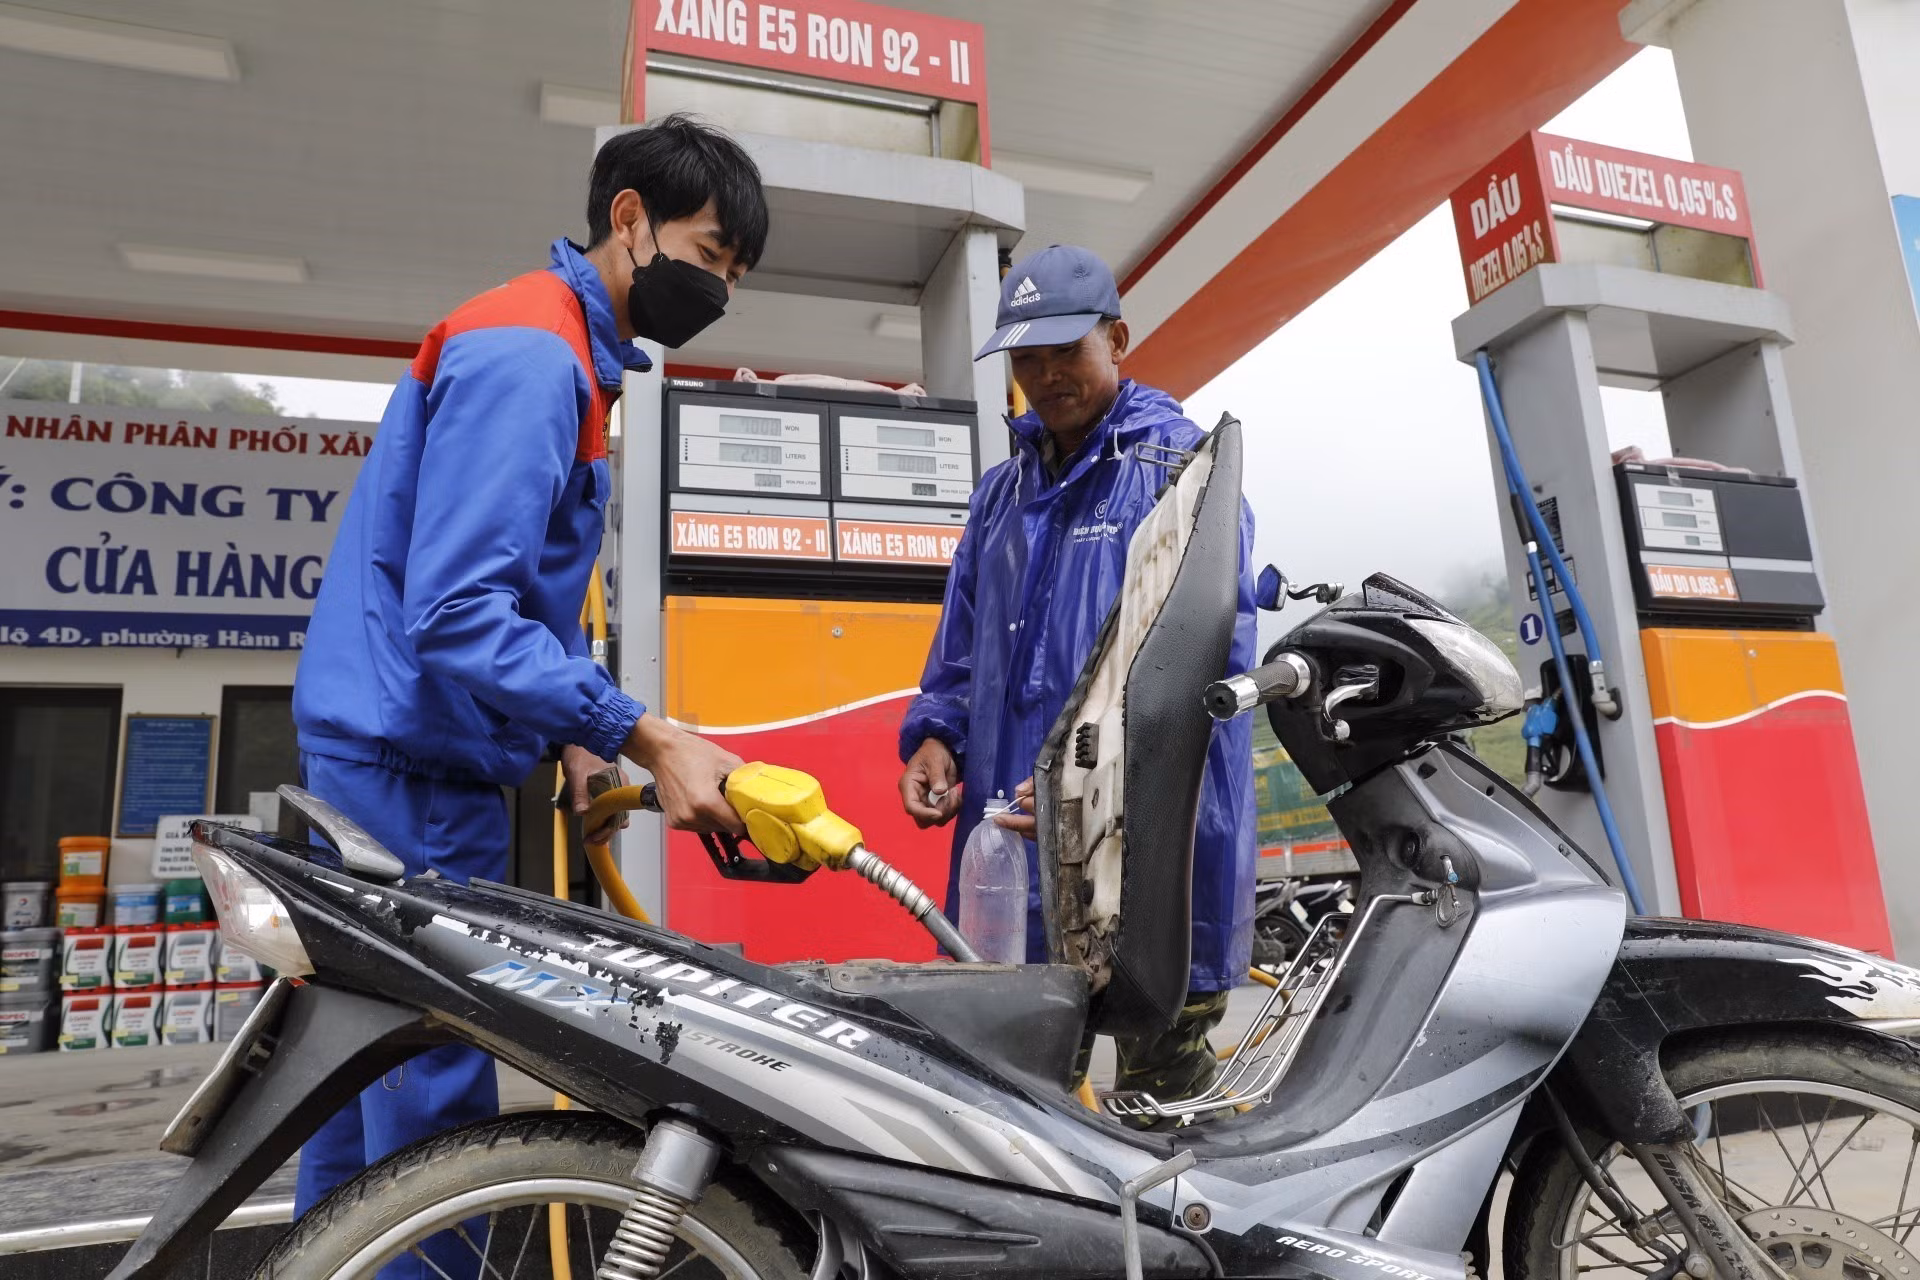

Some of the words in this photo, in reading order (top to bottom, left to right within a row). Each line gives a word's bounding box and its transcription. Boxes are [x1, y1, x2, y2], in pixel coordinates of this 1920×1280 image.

[759, 4, 797, 54] E5
[808, 12, 873, 68] RON
[883, 28, 920, 76] 92
[929, 56, 941, 66] -
[950, 39, 970, 86] II
[1550, 143, 1593, 194] DẦU
[1595, 159, 1664, 208] DIEZEL
[1663, 173, 1737, 221] 0,05%S
[1470, 172, 1521, 240] DẦU
[1469, 247, 1506, 301] DIEZEL
[1011, 292, 1041, 307] adidas
[673, 379, 704, 388] TATSUNO
[5, 414, 112, 443] NHÂN
[123, 421, 217, 449] PHÂN
[229, 425, 308, 454] PHỐI
[50, 472, 245, 518] CÔNG
[266, 487, 340, 523] TY
[676, 518, 720, 548] XĂNG
[723, 525, 743, 549] E5
[747, 525, 779, 550] RON
[783, 527, 802, 551] 92
[815, 528, 826, 553] II
[842, 527, 882, 556] XĂNG
[886, 533, 904, 557] E5
[907, 534, 938, 559] RON
[46, 531, 158, 596] CỬA
[174, 542, 323, 600] HÀNG
[0, 626, 30, 645] lộ
[38, 626, 92, 646] 4D,
[101, 627, 210, 648] phường
[218, 630, 280, 648] Hàm
[1523, 616, 1540, 641] 1
[1275, 1235, 1347, 1258] AERO
[1346, 1254, 1435, 1280] SPORT
